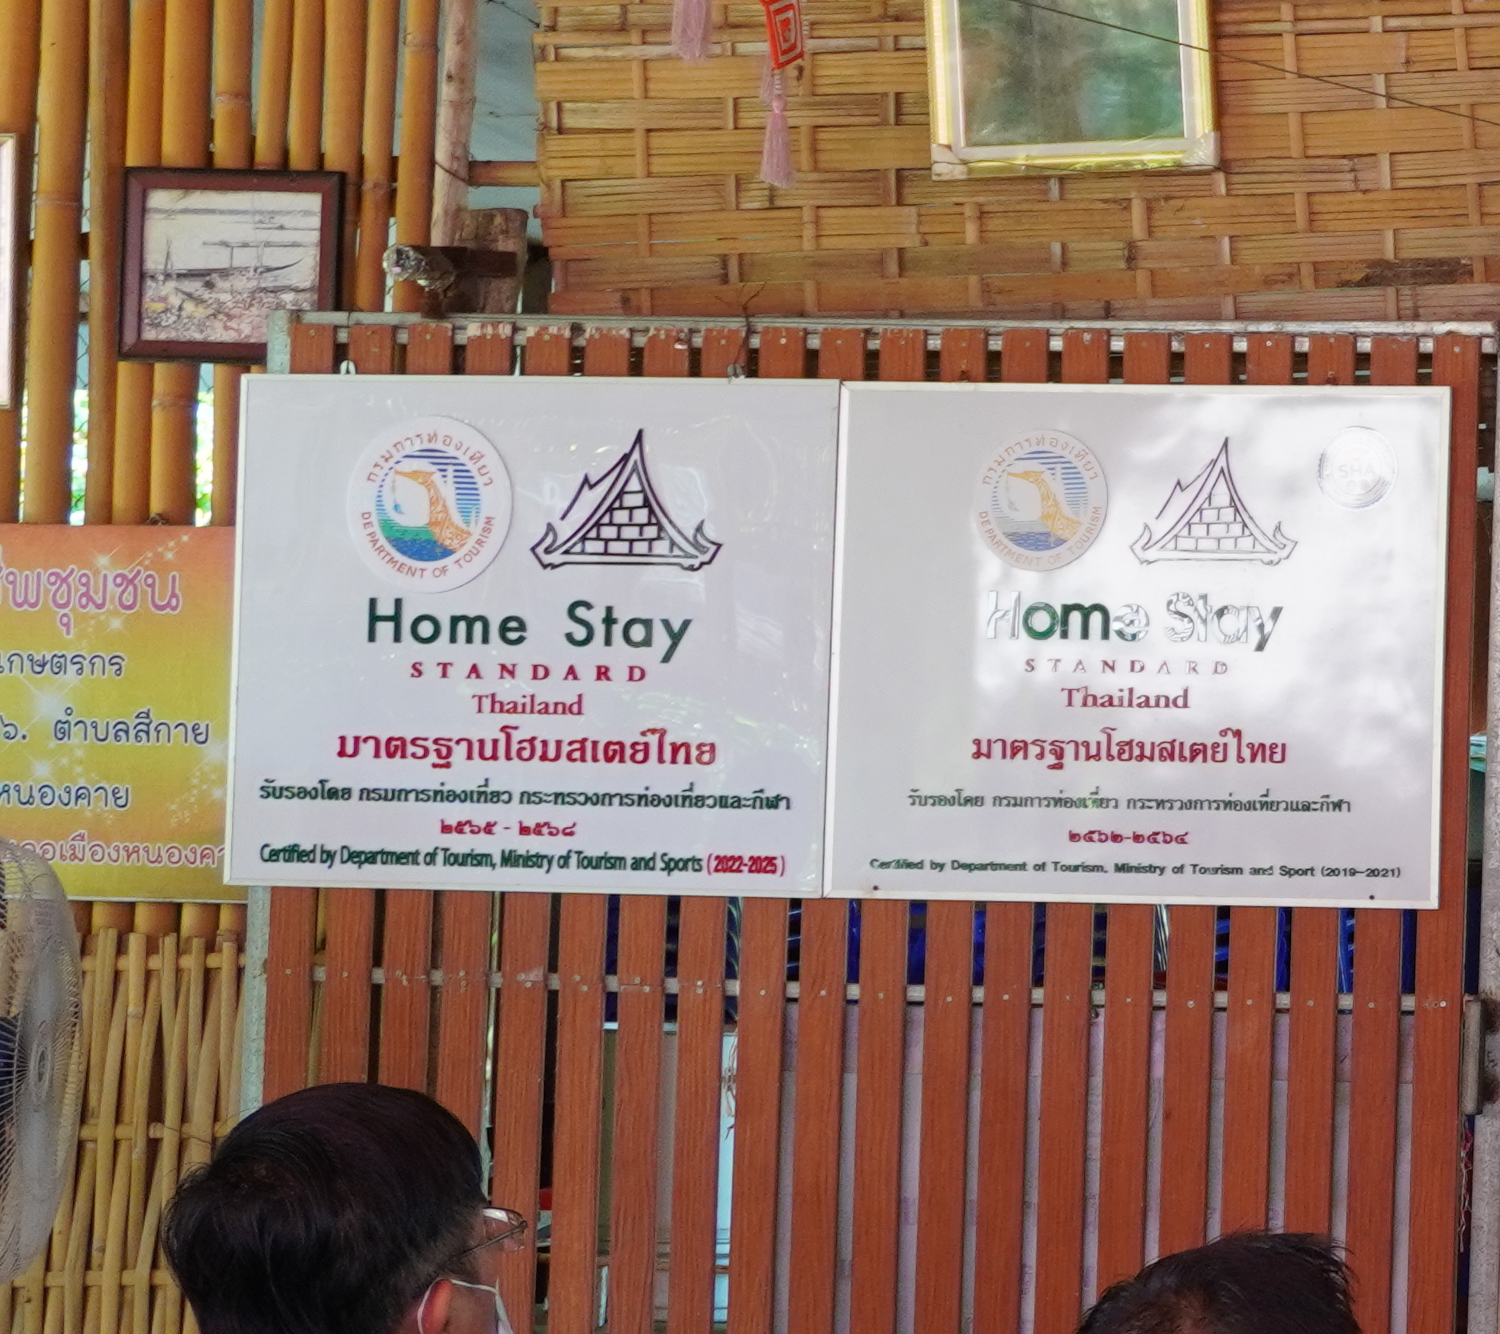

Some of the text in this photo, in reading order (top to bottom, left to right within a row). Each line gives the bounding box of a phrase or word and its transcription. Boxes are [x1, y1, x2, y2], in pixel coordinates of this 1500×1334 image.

[1338, 463, 1377, 478] SHA
[361, 511, 496, 579] DEPARTMENT OF TOURISM
[978, 505, 1102, 567] DEPARTMENT OF TOURISM
[0, 564, 182, 637] พชุมชน
[367, 597, 693, 664] Home Stay
[986, 589, 1284, 652] Home Stay
[410, 661, 648, 682] STANDARD
[1024, 658, 1229, 676] STANDARD
[472, 693, 584, 716] Thailand
[1061, 685, 1191, 709] Thailand
[53, 707, 211, 746] ตำบลสีกาย
[336, 726, 718, 769] มาตรฐานโฮมสเตย์ไทย
[971, 727, 1288, 770] มาตรฐานโฮมสเตย์ไทย
[259, 777, 792, 810] รับรองโดย กรมการท่องเที่ยว กระทรวงการท่องเที่ยวและกีฬา
[907, 785, 1352, 813] รับรองโดย กรมการท่องเที่ยว กระทรวงการท่องเที่ยวและกีฬา
[440, 819, 497, 835] ๒๕๖๕
[518, 820, 577, 837] ๒๕๖๘
[260, 843, 317, 864] Certified
[320, 845, 337, 869] by
[340, 846, 420, 870] Department
[424, 846, 440, 866] of
[441, 847, 496, 871] Tourism,
[500, 848, 554, 874] Ministry
[557, 850, 572, 871] of
[574, 850, 626, 872] Tourism
[630, 852, 656, 872] and
[660, 852, 703, 877] Sports
[869, 858, 925, 871] Certified
[930, 859, 946, 873] by
[951, 859, 1028, 874] Department
[1033, 860, 1047, 872] of
[1114, 862, 1166, 876] Ministry
[1172, 863, 1184, 875] of
[1190, 863, 1244, 876] Tourism
[1249, 864, 1273, 876] and
[1278, 864, 1316, 879] Sport
